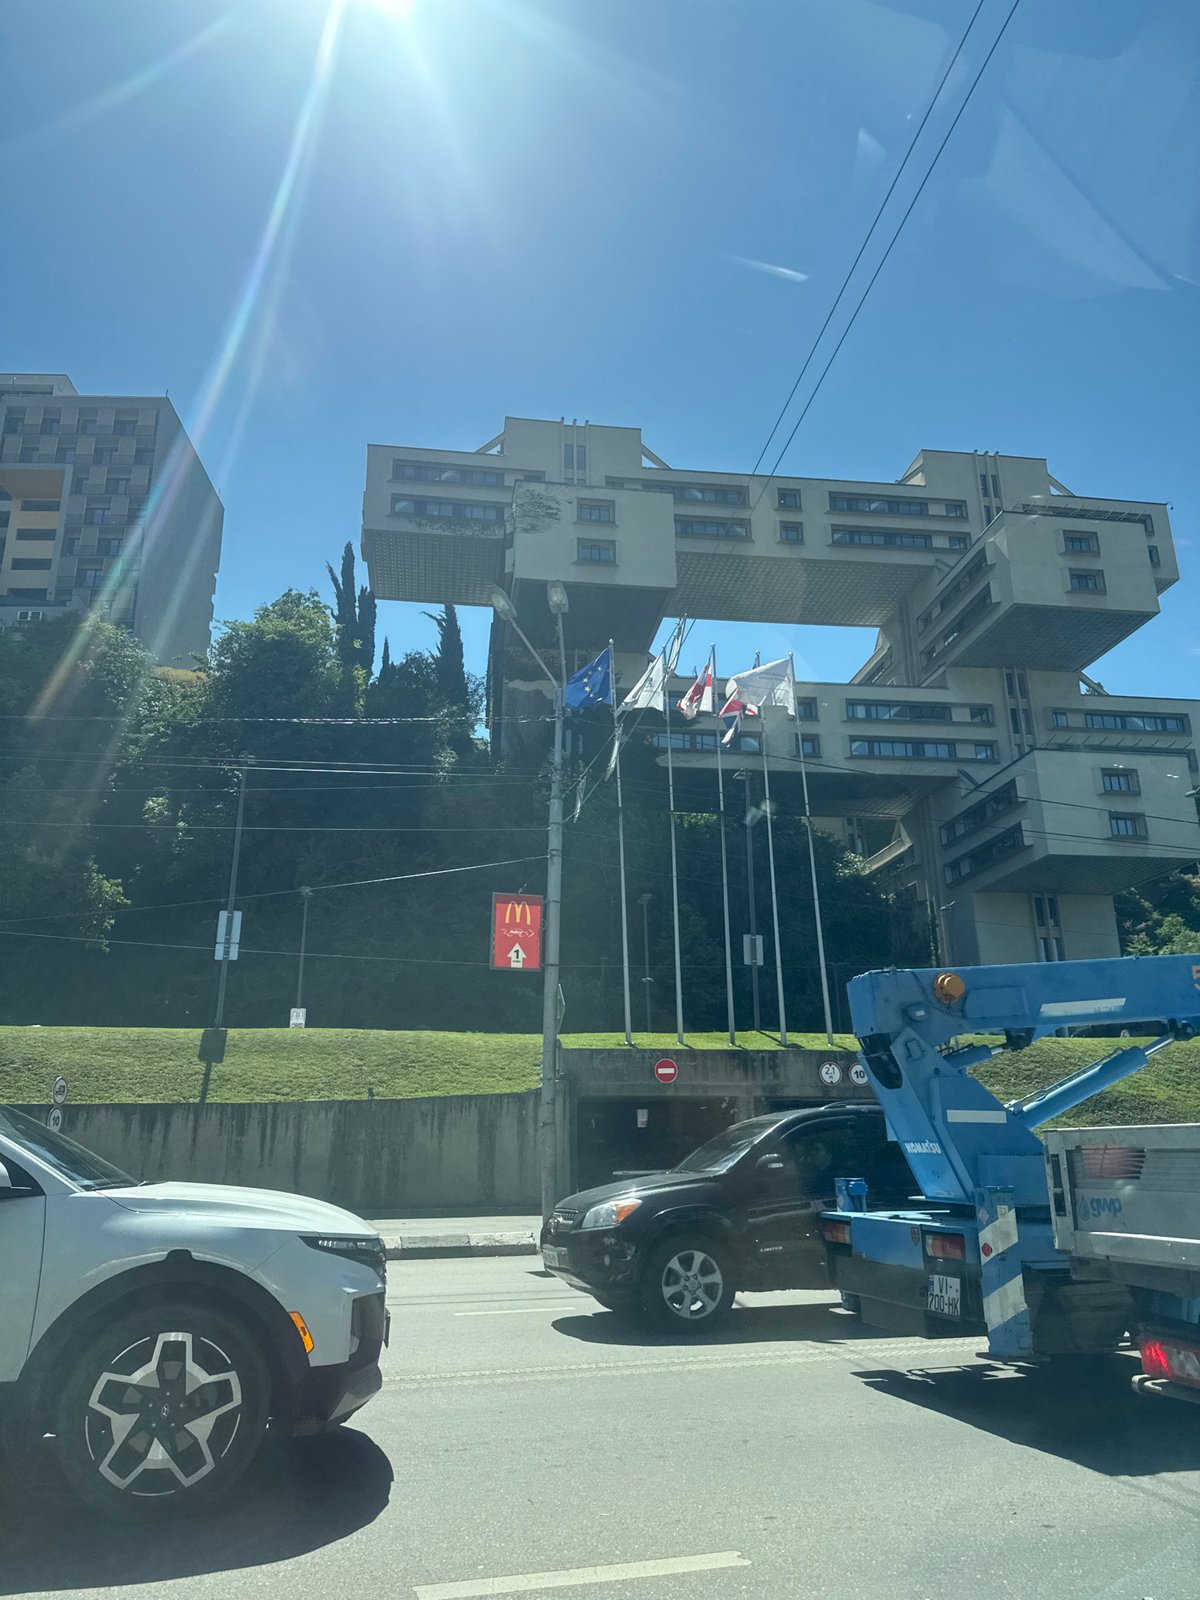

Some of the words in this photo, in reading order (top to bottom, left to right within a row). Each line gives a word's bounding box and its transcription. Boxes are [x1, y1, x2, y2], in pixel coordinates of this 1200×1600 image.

[514, 949, 520, 960] 1
[853, 1070, 866, 1079] 10
[52, 1115, 60, 1127] 10
[1090, 1197, 1122, 1218] gwp
